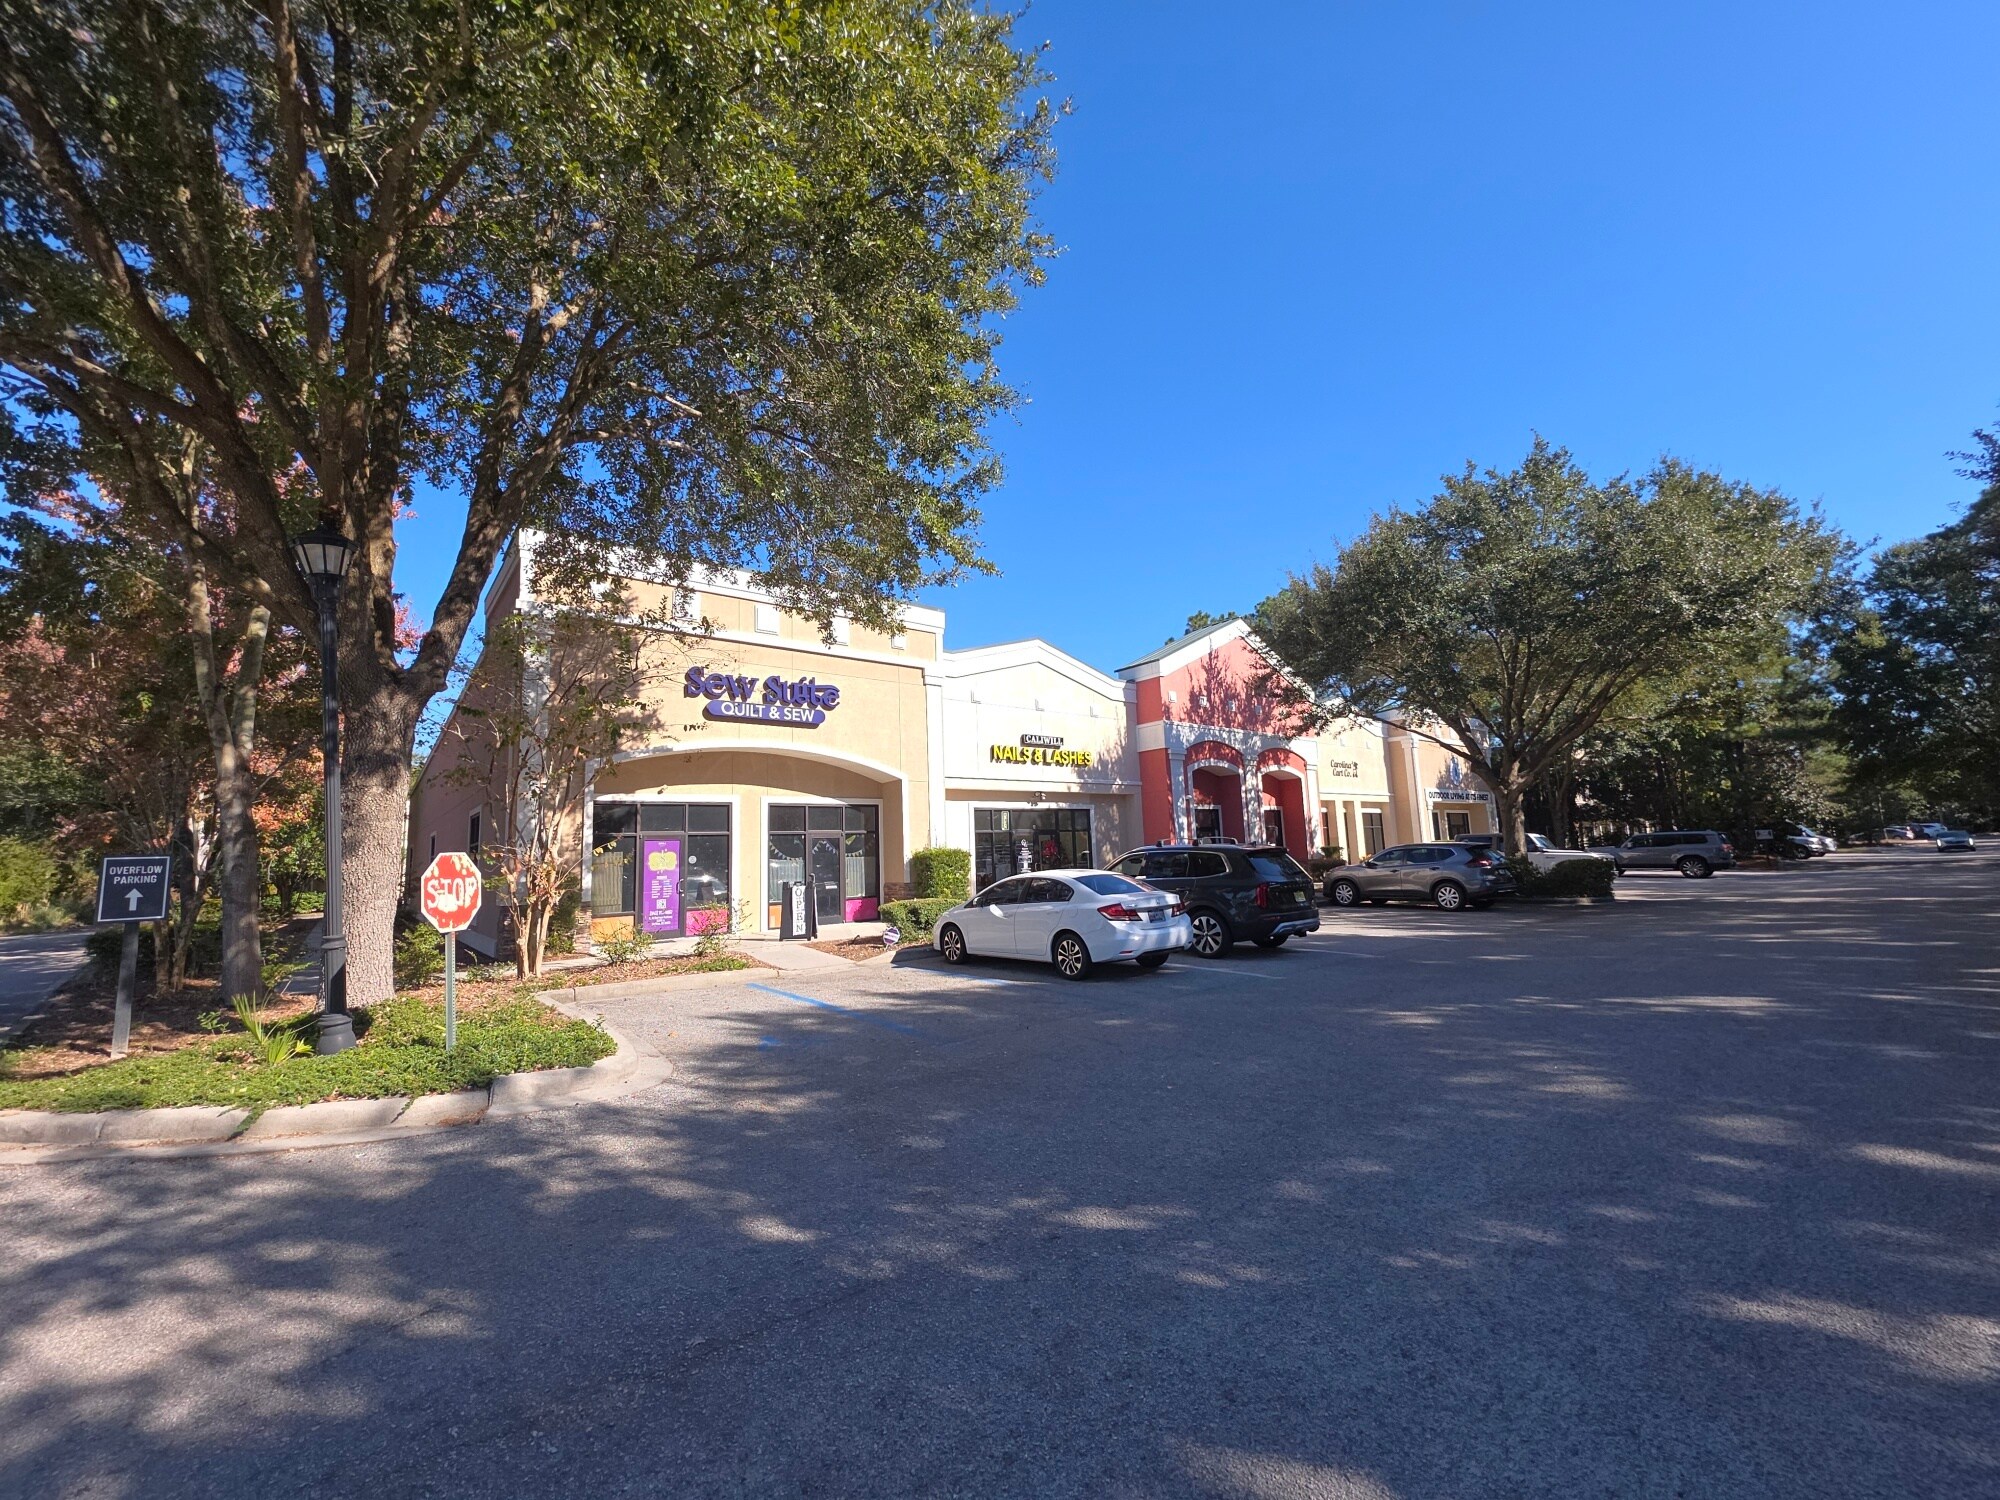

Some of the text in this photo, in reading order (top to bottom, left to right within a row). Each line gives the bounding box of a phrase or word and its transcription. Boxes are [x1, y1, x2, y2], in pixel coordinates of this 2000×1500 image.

[685, 666, 840, 711] Sew Suite
[721, 702, 815, 722] QUILT & SEW
[993, 745, 1094, 766] NAILS & LASHES
[1429, 792, 1450, 800] OUTDOOR
[109, 865, 163, 875] OVERFLOW
[113, 875, 158, 885] PARKING
[427, 876, 477, 909] STOP
[794, 888, 803, 933] OPEN
